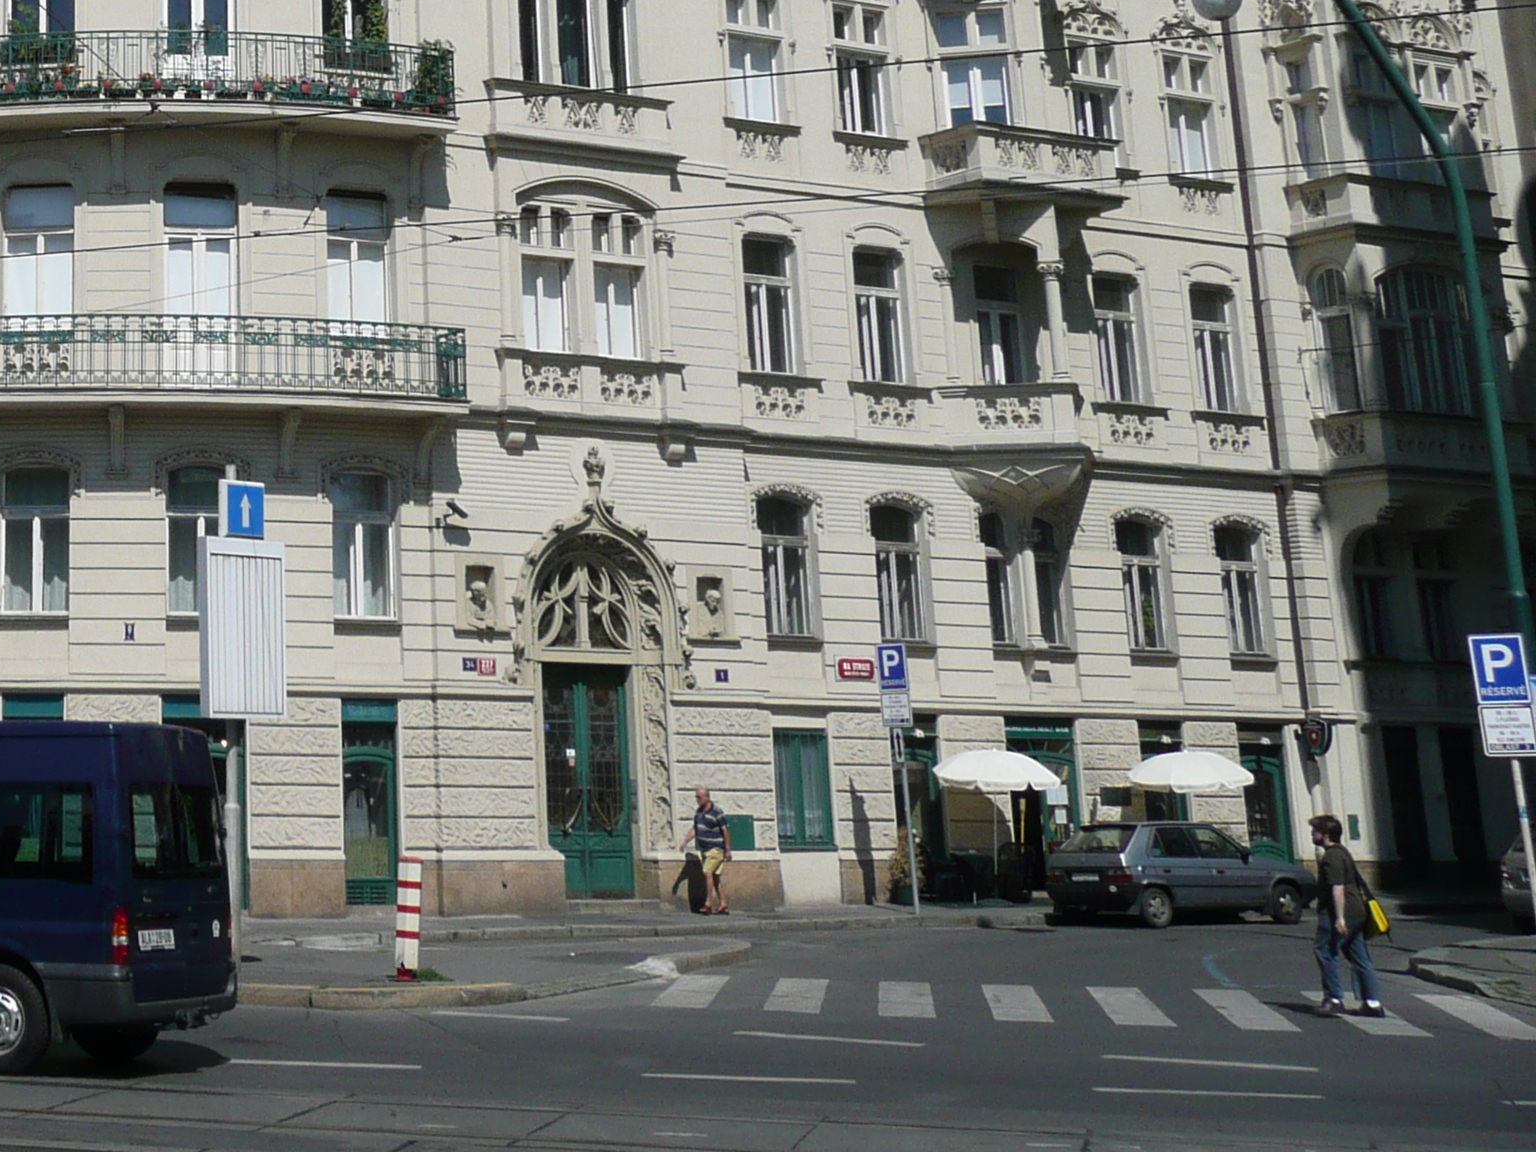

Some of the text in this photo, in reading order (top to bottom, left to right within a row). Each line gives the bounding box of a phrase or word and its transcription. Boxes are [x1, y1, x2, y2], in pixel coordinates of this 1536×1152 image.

[882, 649, 899, 677] P
[1480, 643, 1514, 683] P
[1481, 685, 1527, 696] RÉSERVÉ
